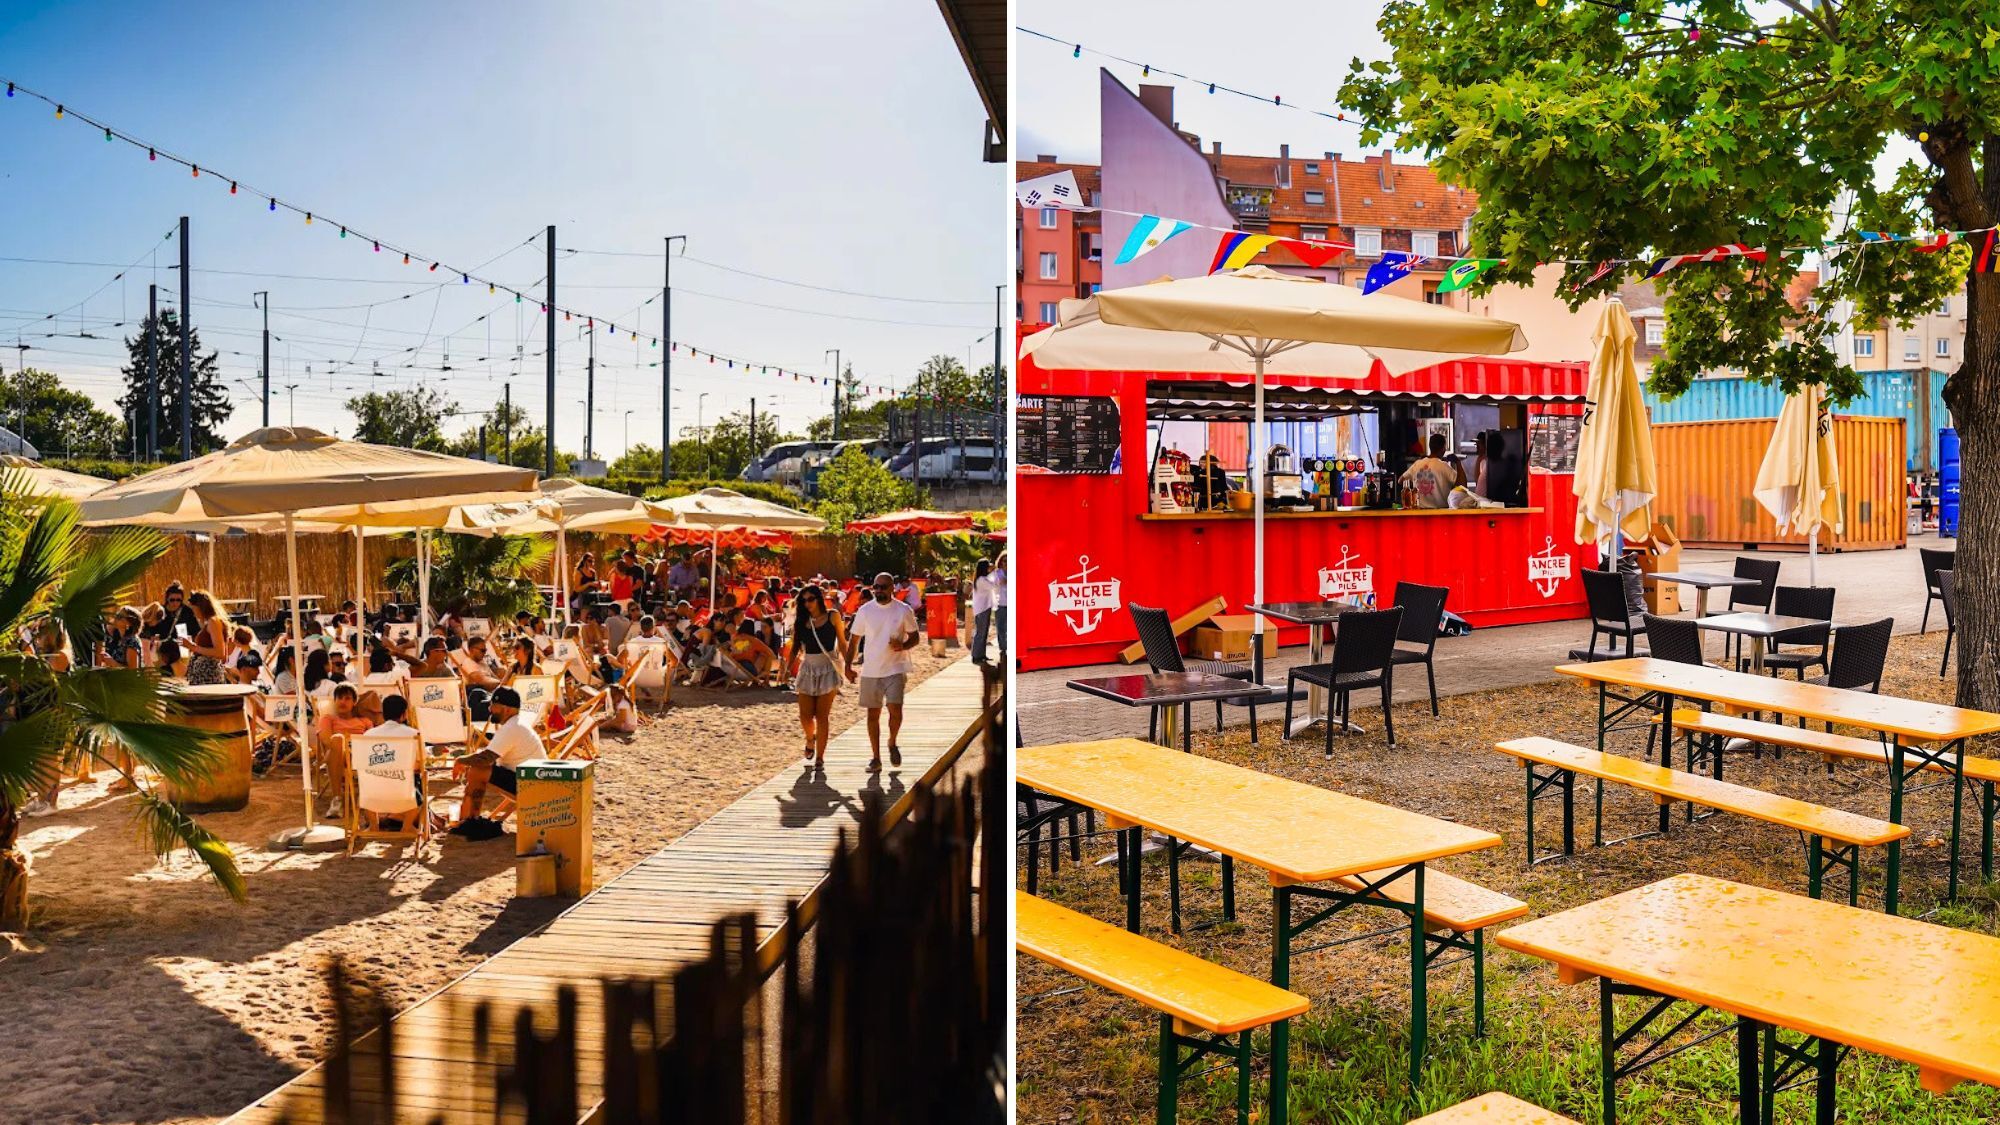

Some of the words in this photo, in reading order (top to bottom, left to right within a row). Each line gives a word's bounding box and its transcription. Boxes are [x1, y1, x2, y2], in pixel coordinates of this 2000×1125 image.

[1016, 398, 1043, 409] CARTE
[1530, 558, 1566, 570] ANCRE
[1326, 570, 1367, 583] ANCRE
[1056, 584, 1113, 599] ANCRE
[1338, 582, 1357, 590] PILS
[1074, 599, 1097, 607] PILS
[535, 767, 563, 779] Carola
